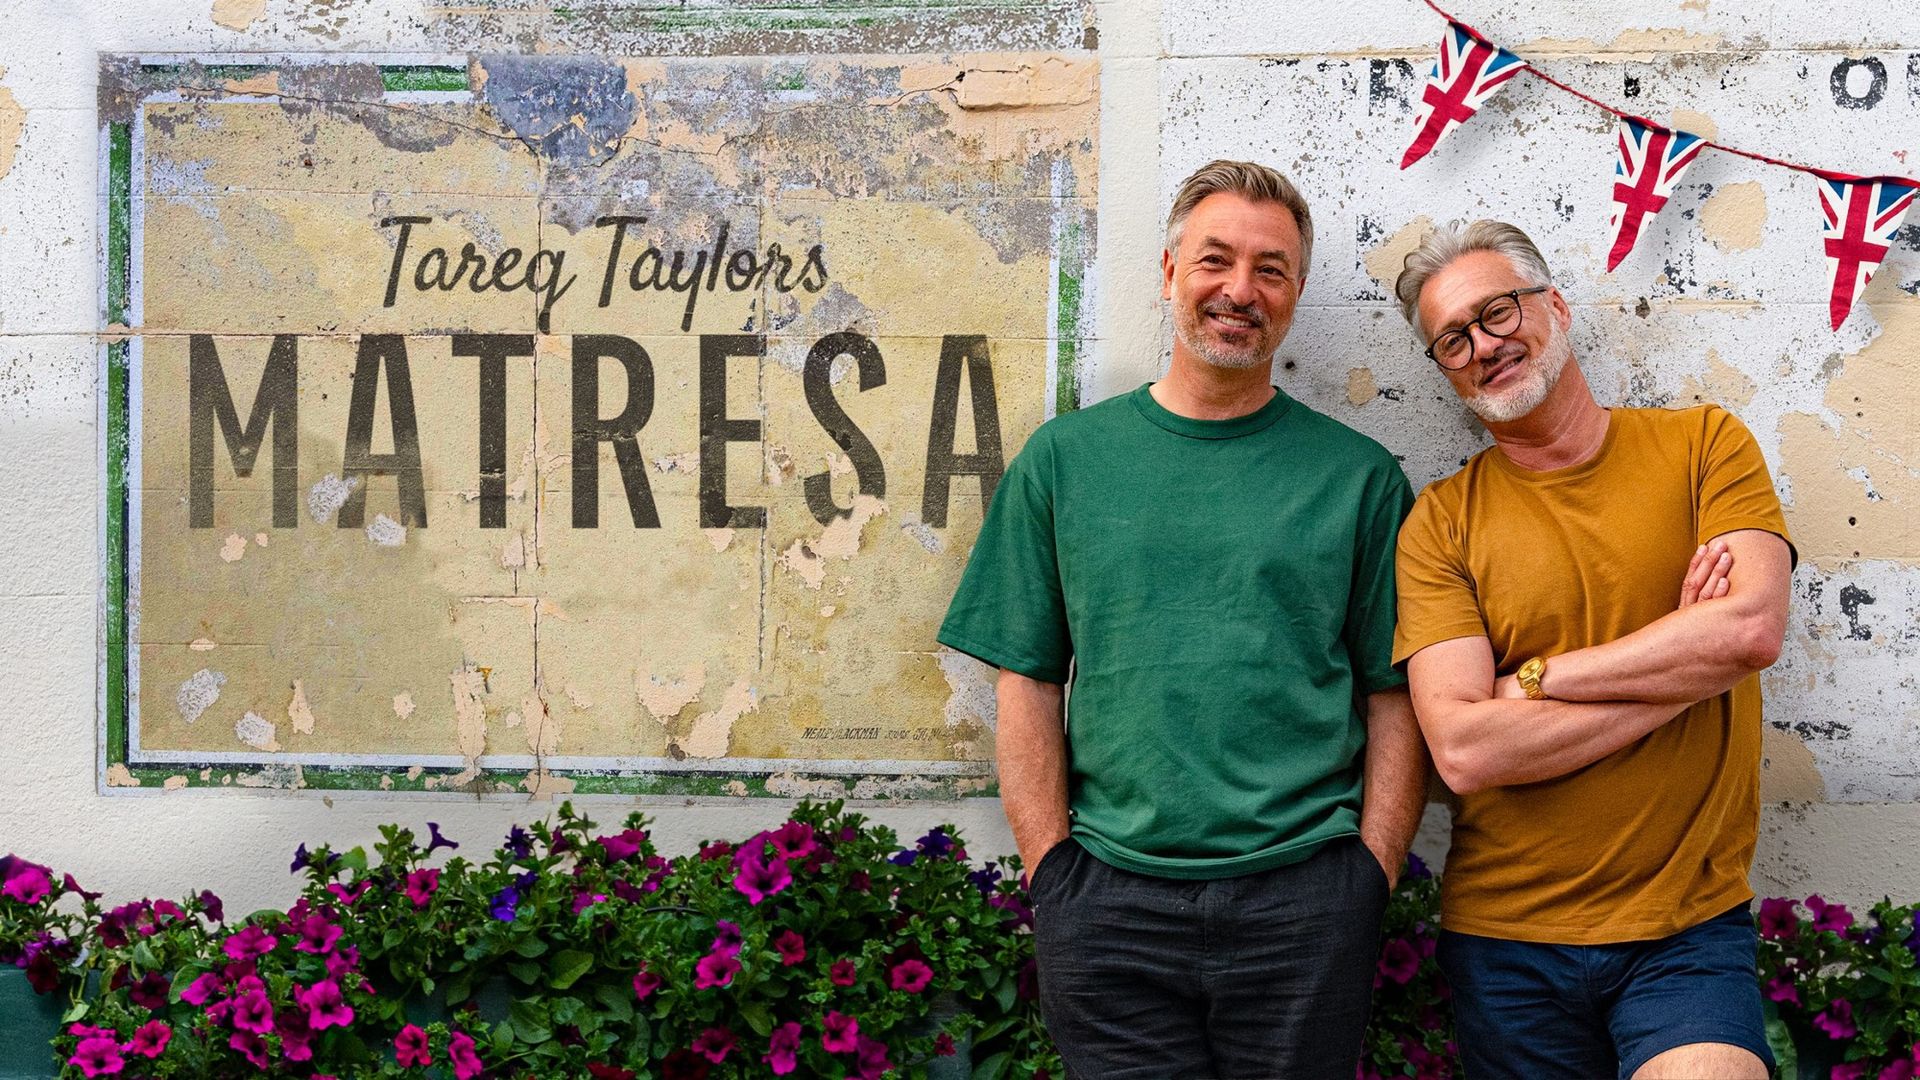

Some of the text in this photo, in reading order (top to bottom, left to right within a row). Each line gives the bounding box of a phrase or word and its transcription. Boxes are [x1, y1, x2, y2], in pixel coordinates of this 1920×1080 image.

[380, 215, 829, 335] Tareq Taylors
[189, 330, 1005, 528] MATRESA
